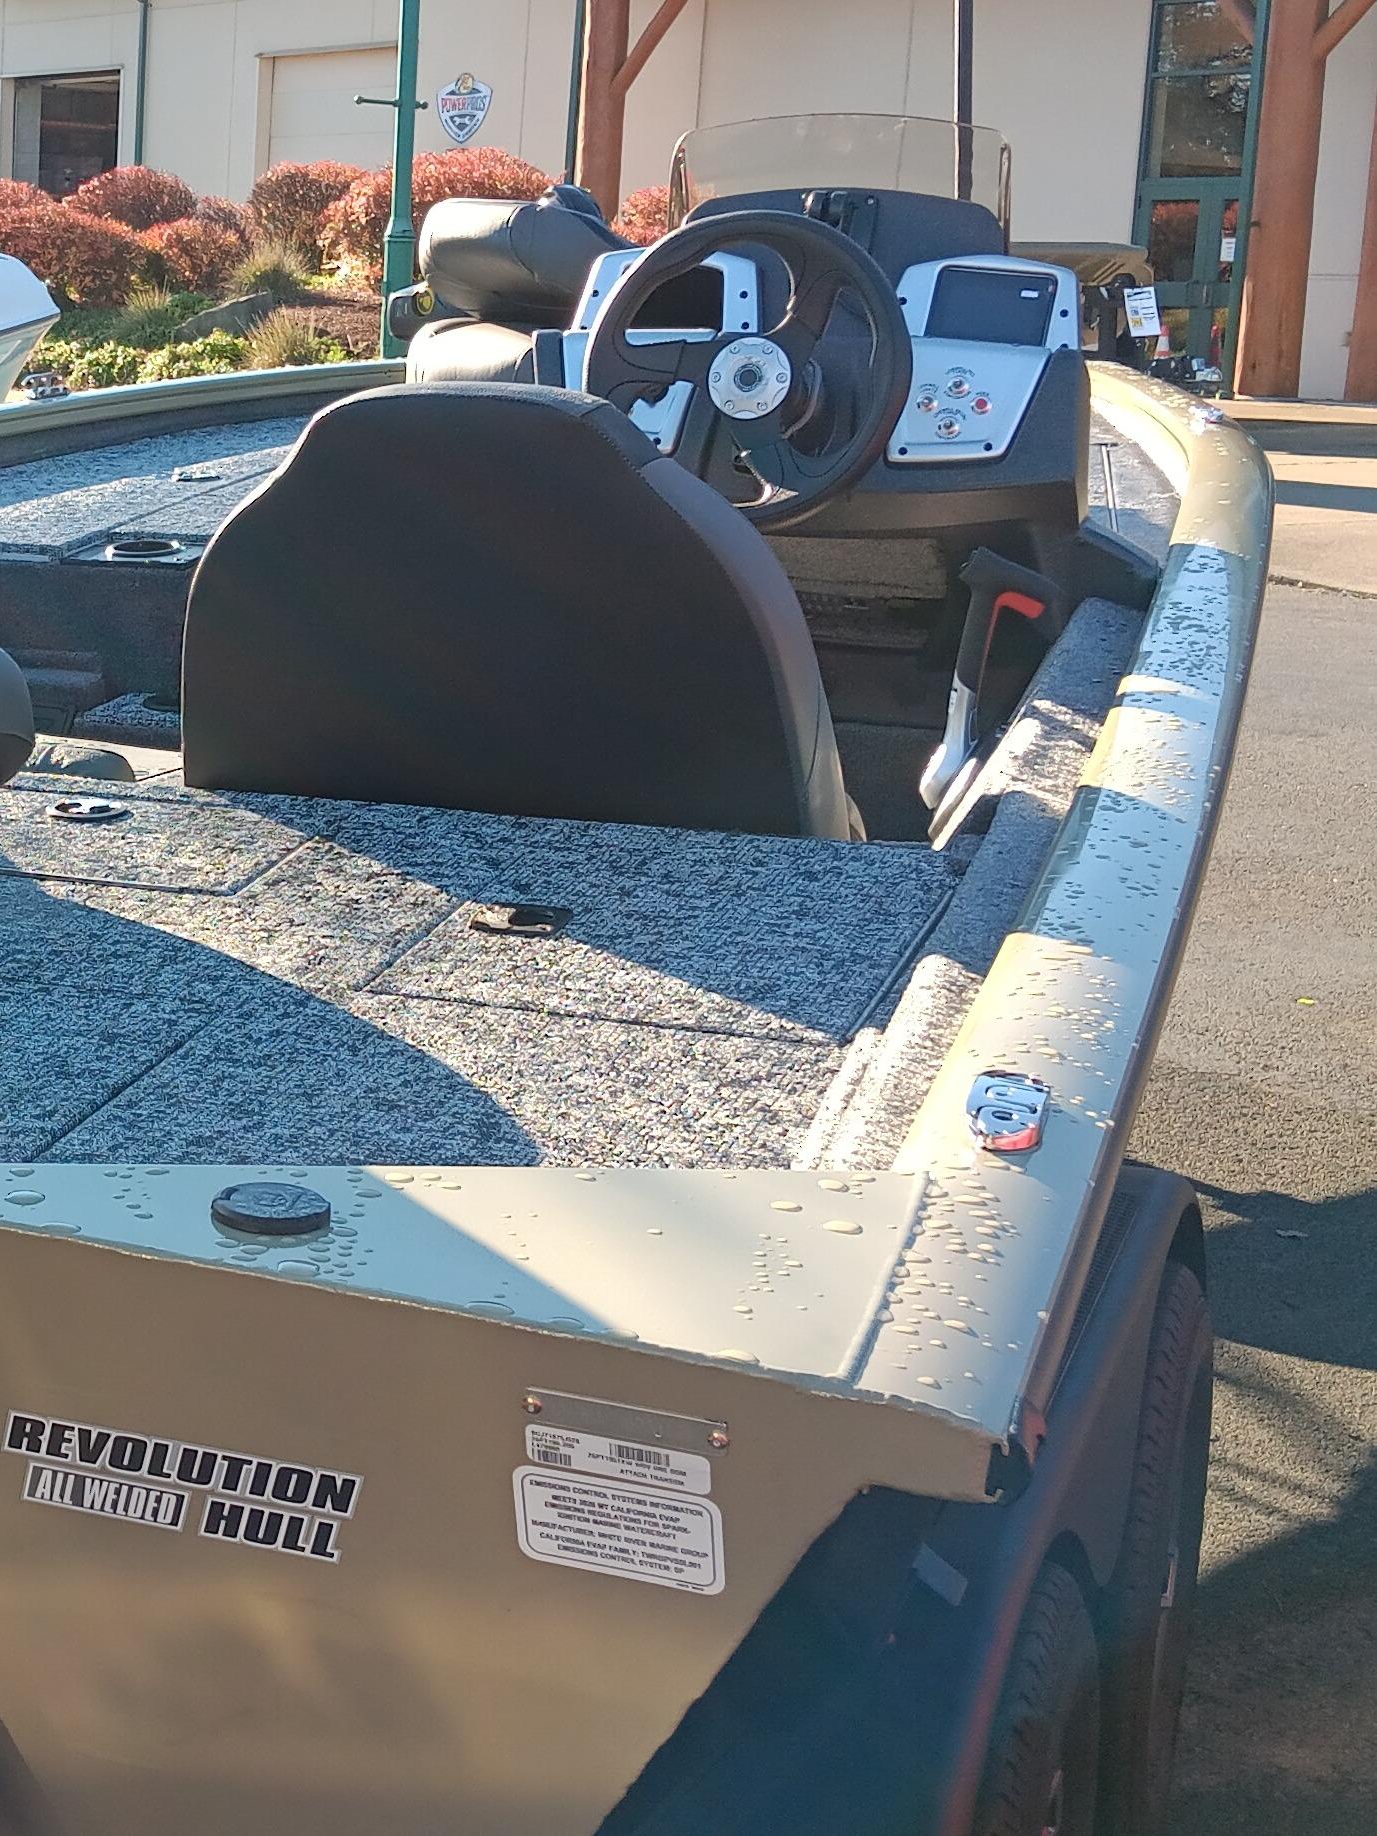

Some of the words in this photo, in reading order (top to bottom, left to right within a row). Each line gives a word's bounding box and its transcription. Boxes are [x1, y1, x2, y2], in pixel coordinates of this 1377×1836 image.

[7, 1415, 356, 1514] REVOLUTION
[34, 1469, 74, 1505] ALL
[83, 1477, 179, 1524] WELDED
[204, 1500, 335, 1559] HULL
